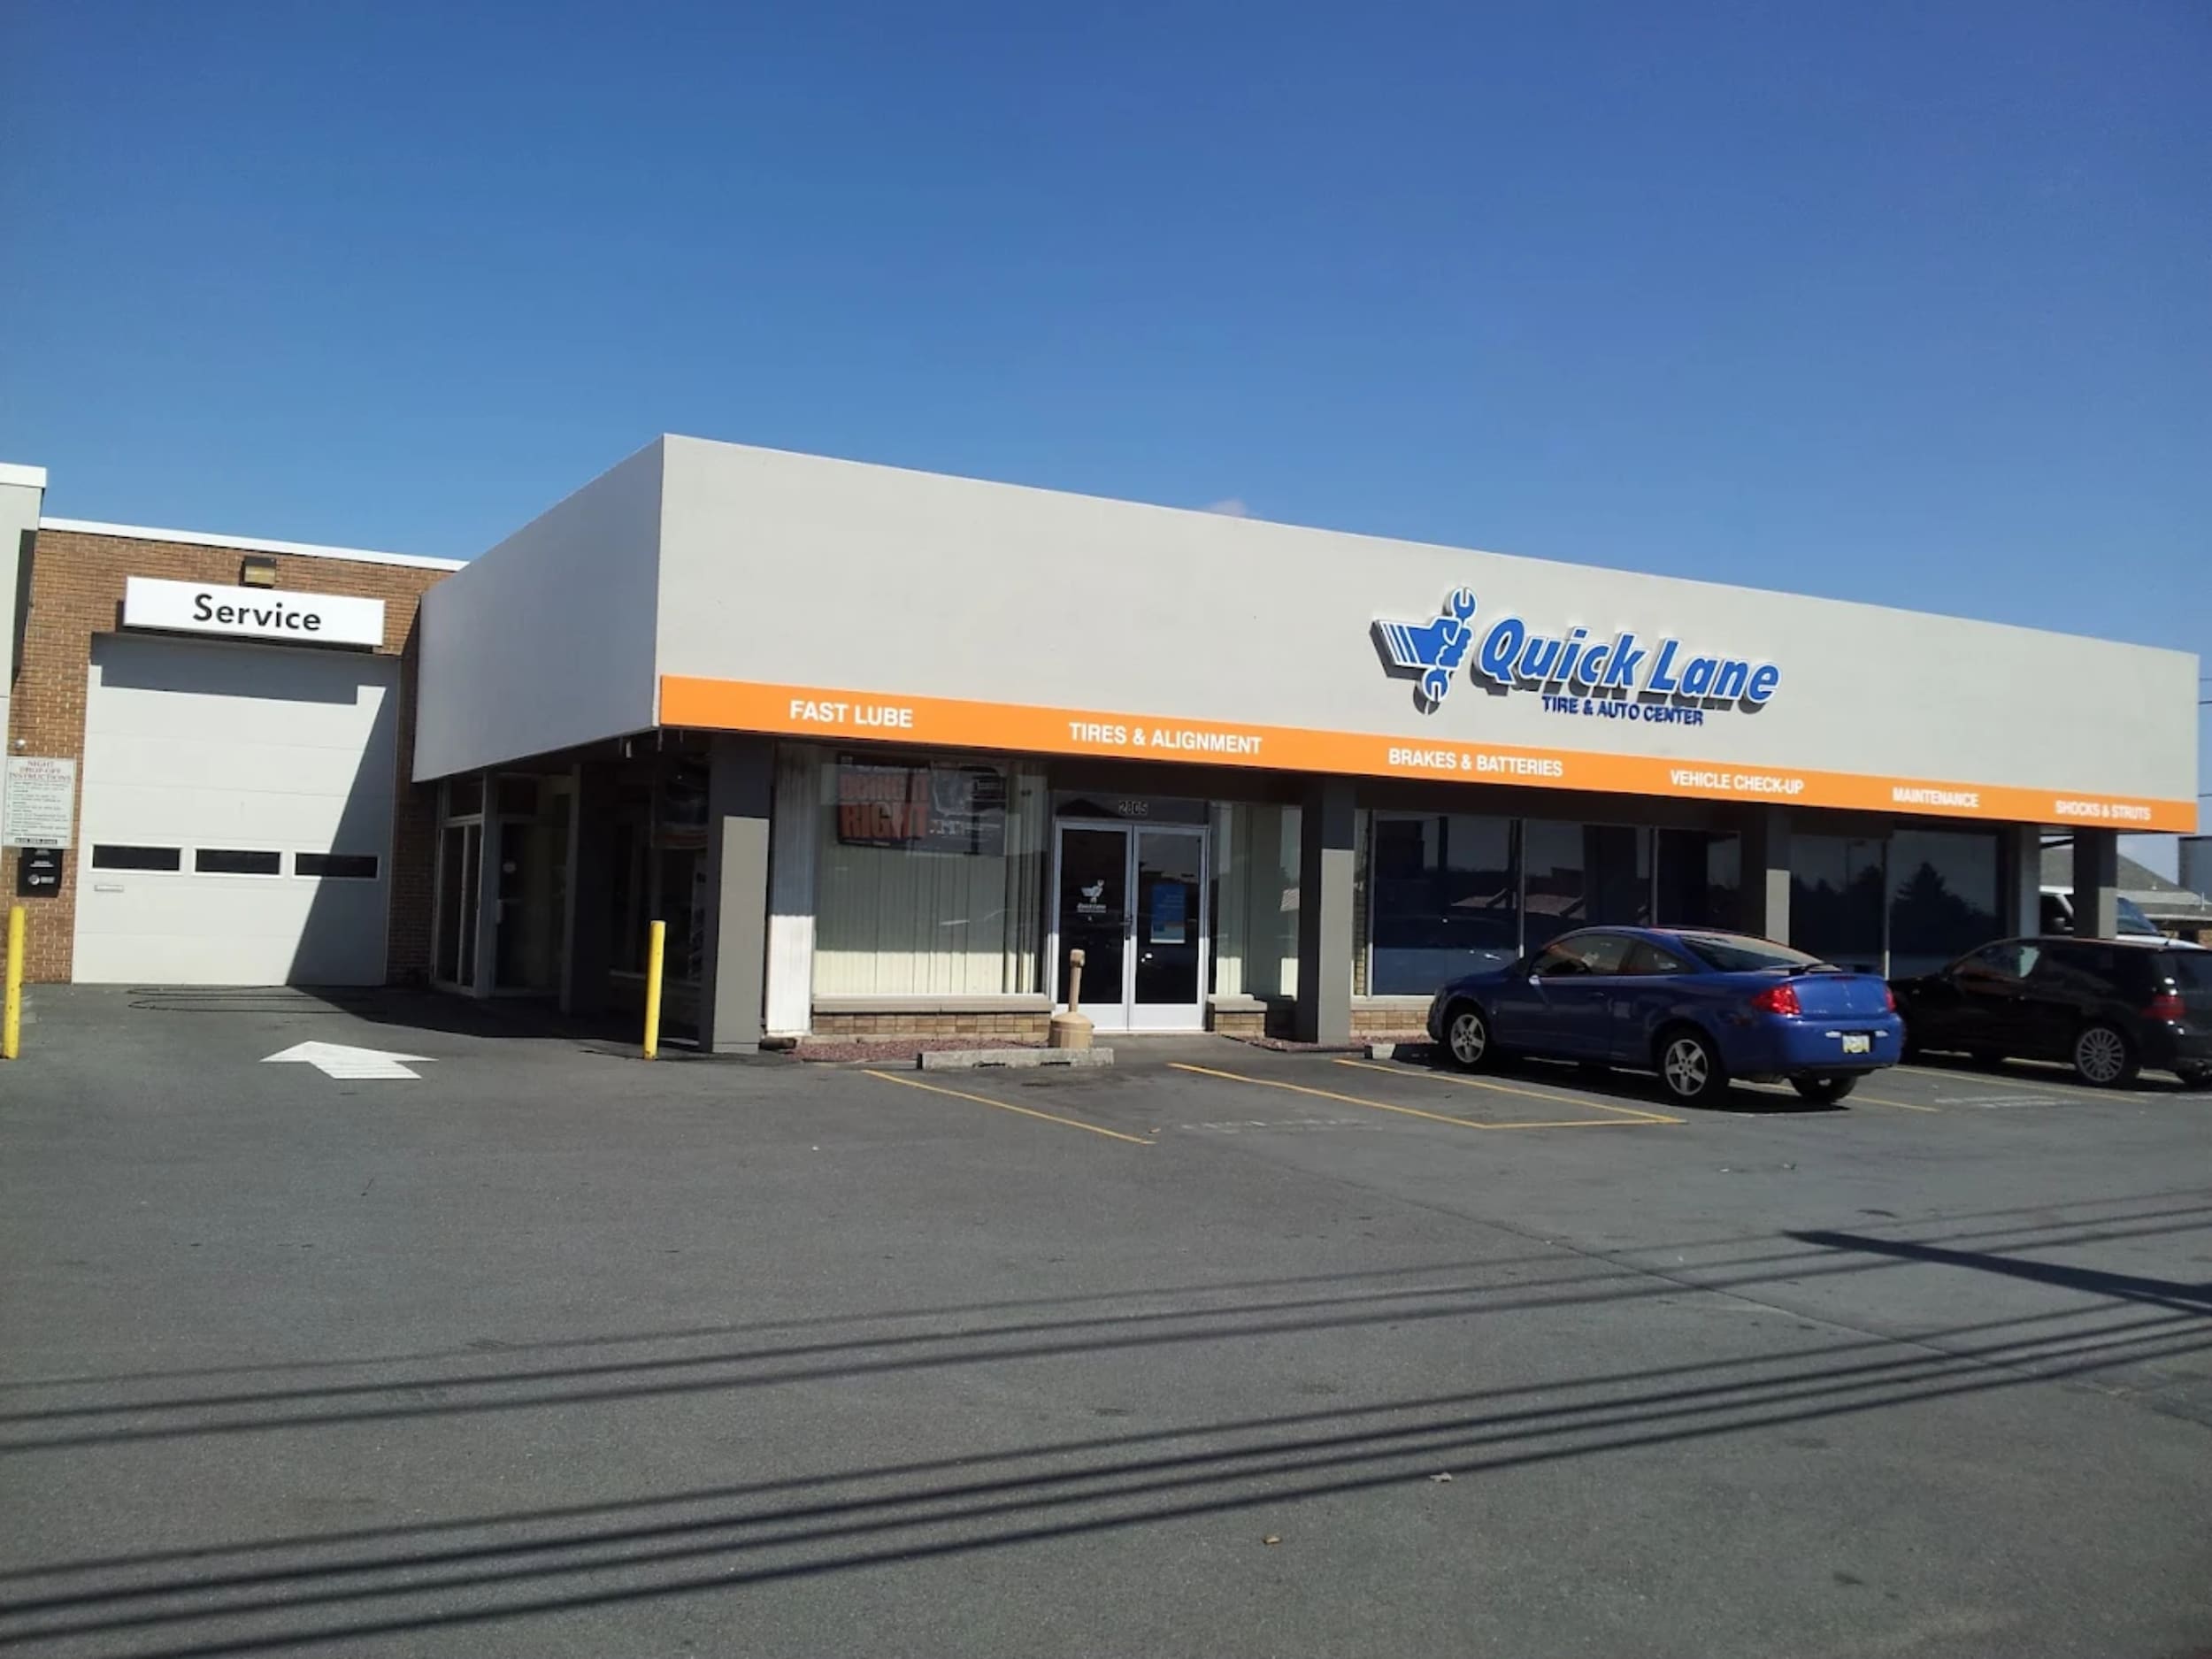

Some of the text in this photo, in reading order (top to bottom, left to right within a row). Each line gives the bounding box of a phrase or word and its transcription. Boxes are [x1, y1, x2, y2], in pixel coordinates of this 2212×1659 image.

[193, 593, 321, 631] Service
[1479, 617, 1781, 703] Quick Lane
[790, 700, 913, 728] FAST LUBE
[1542, 695, 1703, 726] TIRE & AUTO CENTER
[1069, 722, 1263, 754] TIRES & ALIGNMENT
[1388, 748, 1563, 777] BRAKES & BATTERIES
[1671, 769, 1805, 795] VEHICLE CHECK-UP
[1893, 787, 1979, 808] MAINTENANCE
[2055, 799, 2151, 821] SHOCKS & STRUTS
